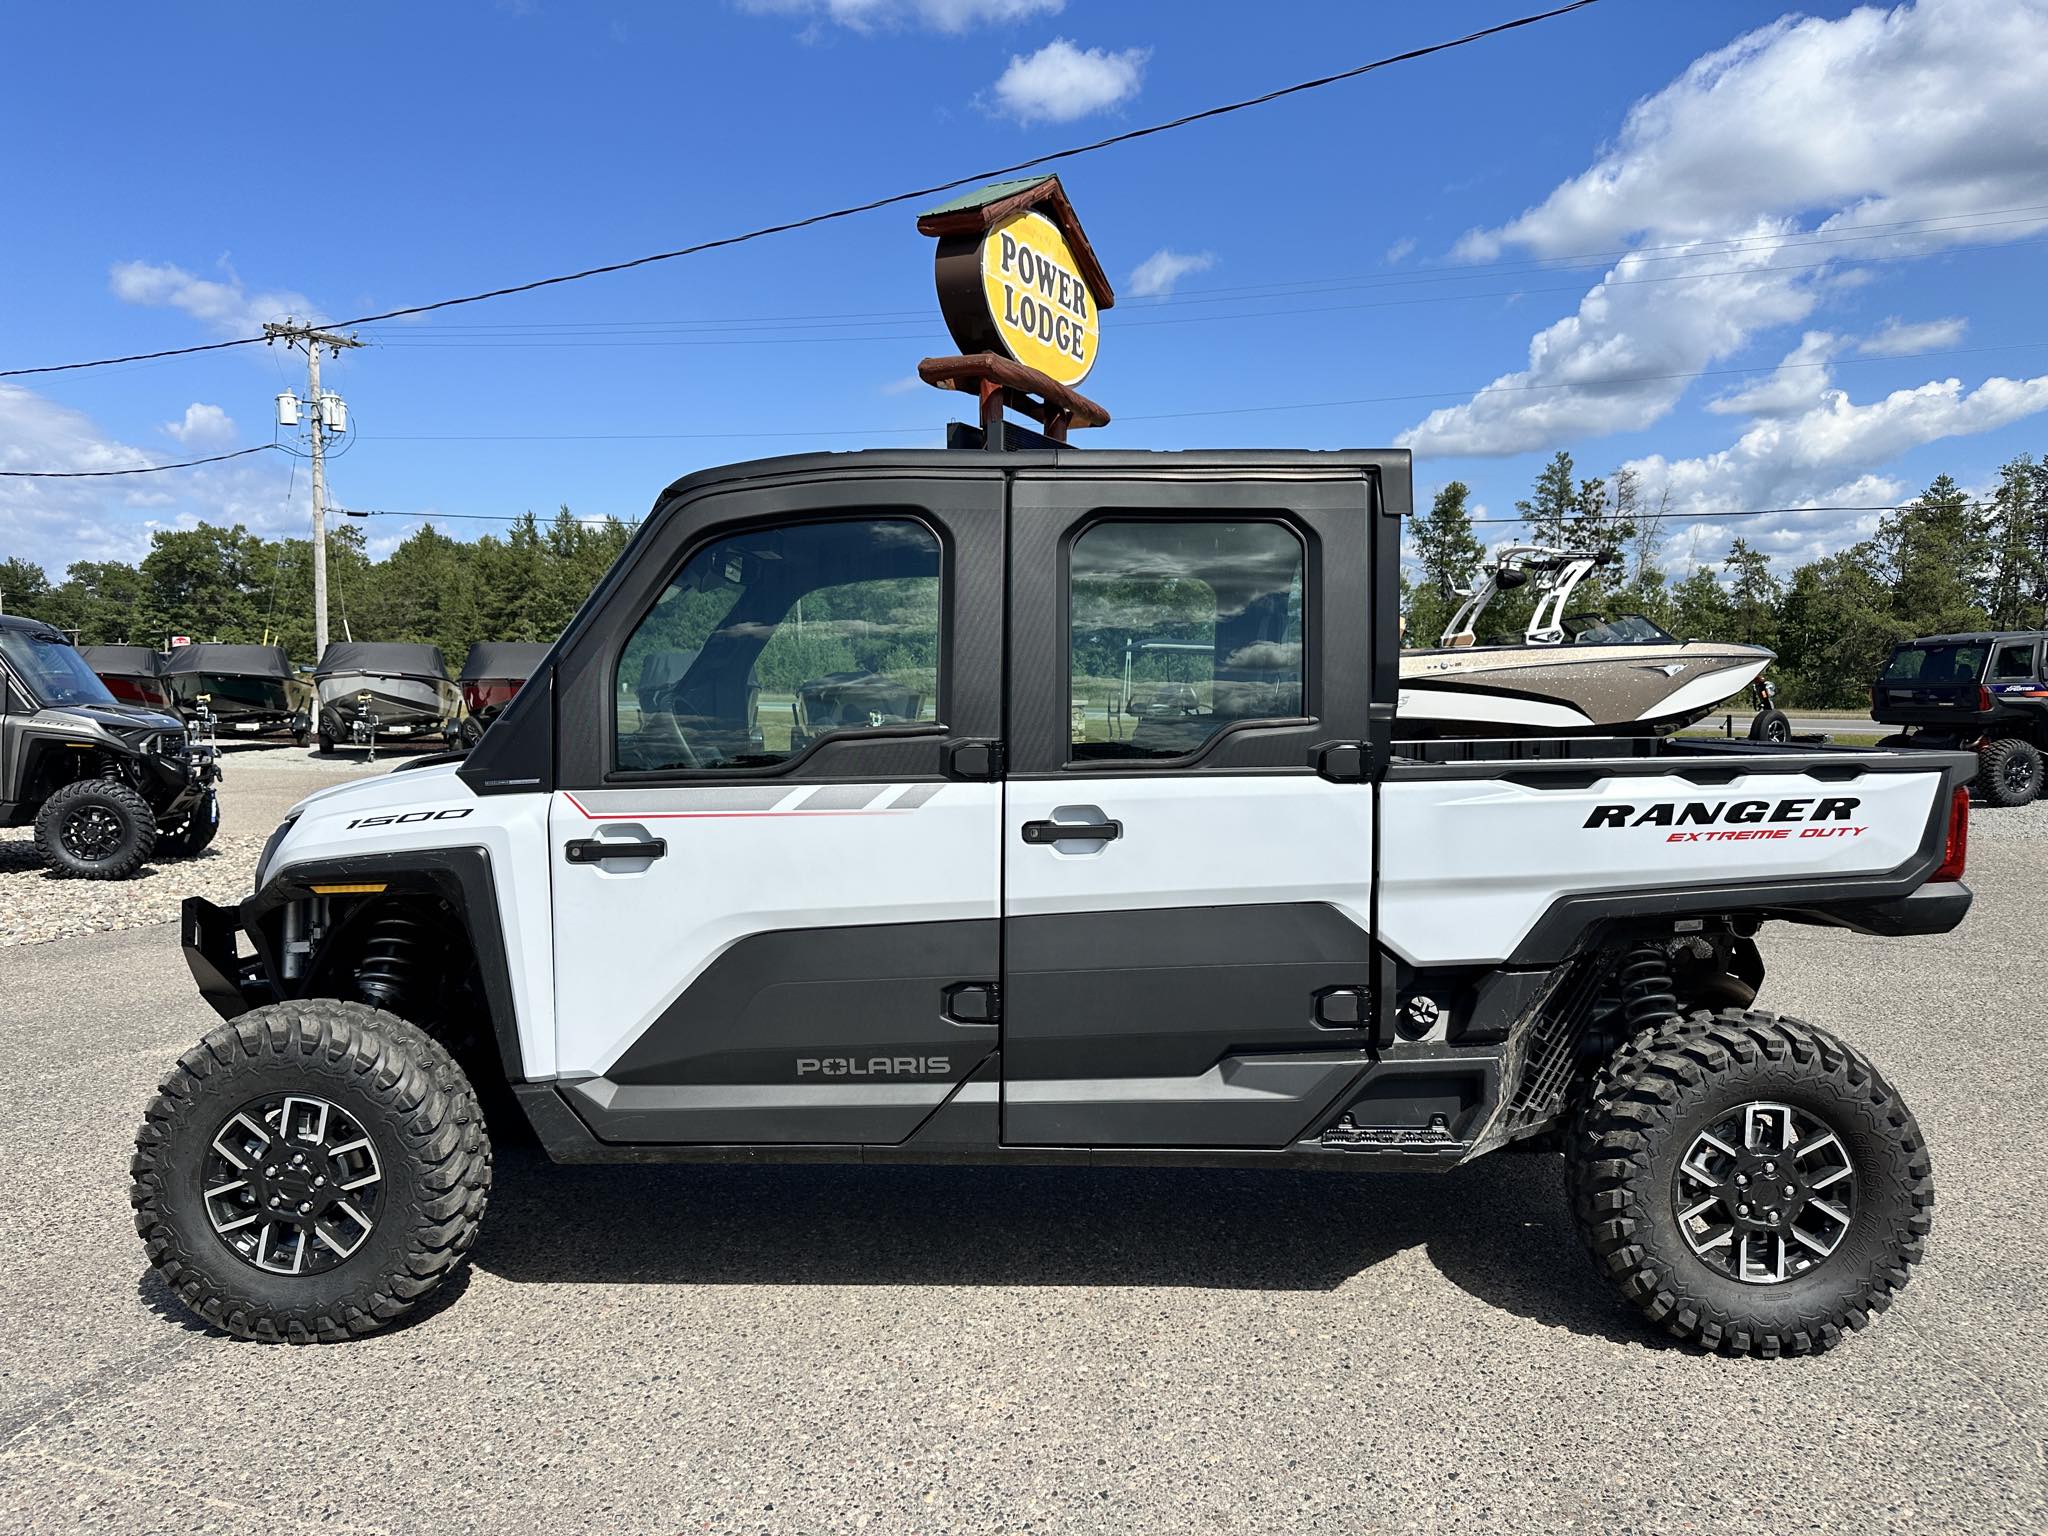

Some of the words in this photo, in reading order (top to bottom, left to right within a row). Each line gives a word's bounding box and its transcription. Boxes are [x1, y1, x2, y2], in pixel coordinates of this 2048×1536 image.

[1000, 232, 1088, 320] POWER
[1004, 284, 1084, 361] LODGE
[345, 808, 475, 830] 1500
[1582, 797, 1862, 829] RANGER
[1665, 828, 1794, 843] EXTREME
[1799, 826, 1870, 840] DUTY
[796, 1056, 951, 1076] POLARIS
